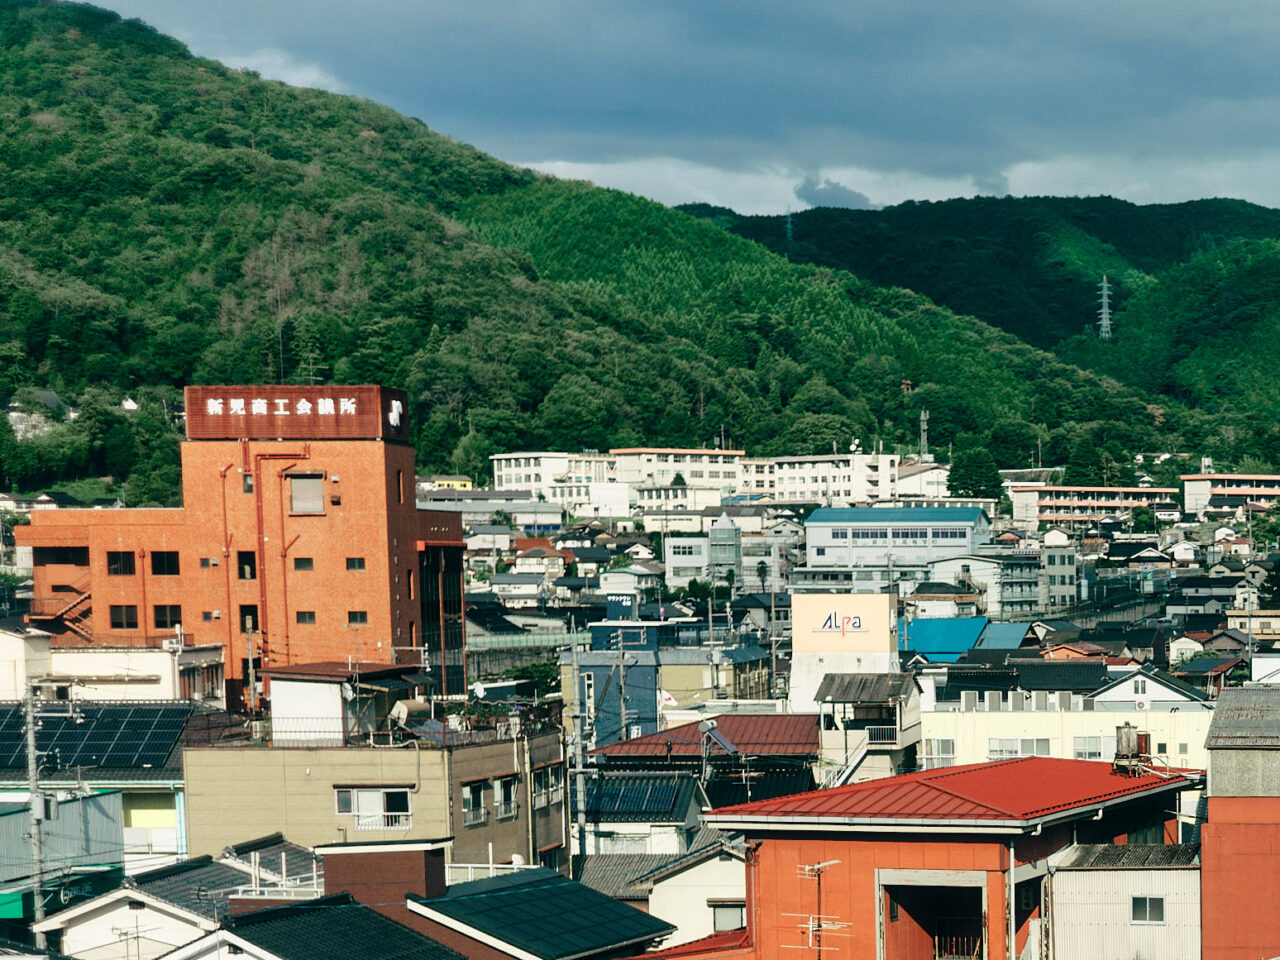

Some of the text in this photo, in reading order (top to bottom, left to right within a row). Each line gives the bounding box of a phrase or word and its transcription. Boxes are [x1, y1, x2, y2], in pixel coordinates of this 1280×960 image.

[207, 398, 357, 415] 新見商工会議所
